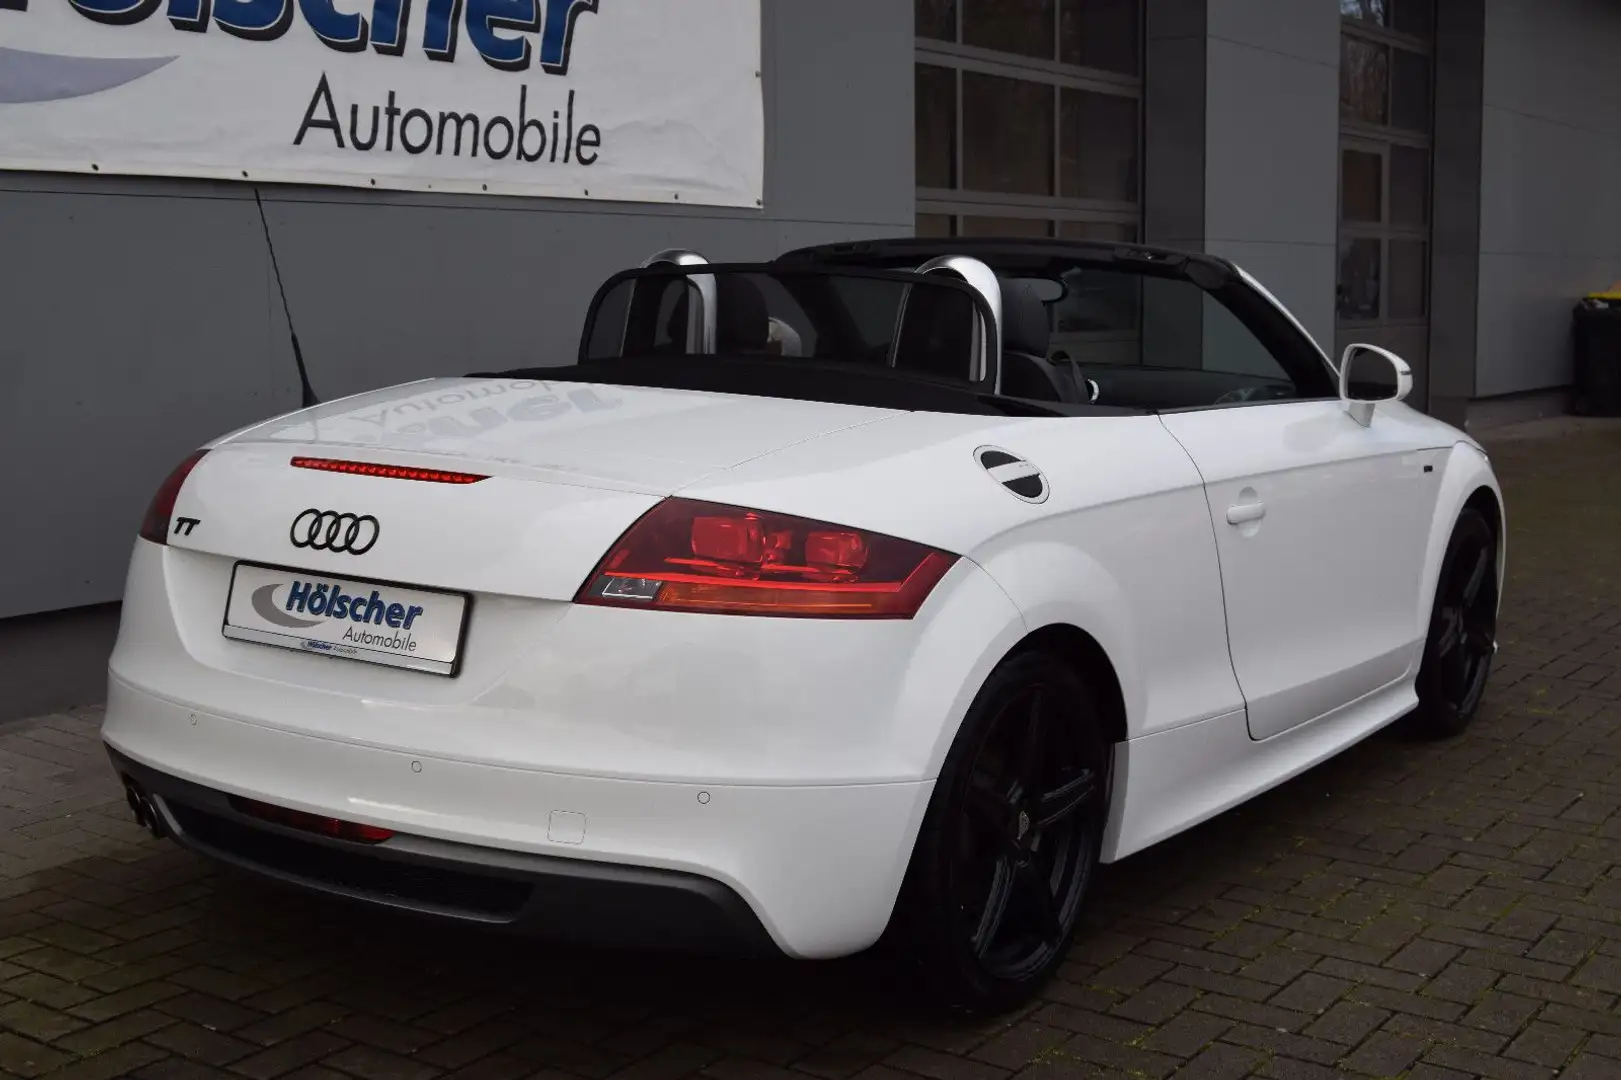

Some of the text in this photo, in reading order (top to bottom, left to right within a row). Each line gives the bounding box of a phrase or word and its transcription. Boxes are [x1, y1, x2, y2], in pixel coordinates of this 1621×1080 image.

[294, 71, 601, 166] Automobile
[174, 516, 201, 536] TT
[286, 580, 424, 630] Hölscher
[342, 625, 417, 652] Automobile
